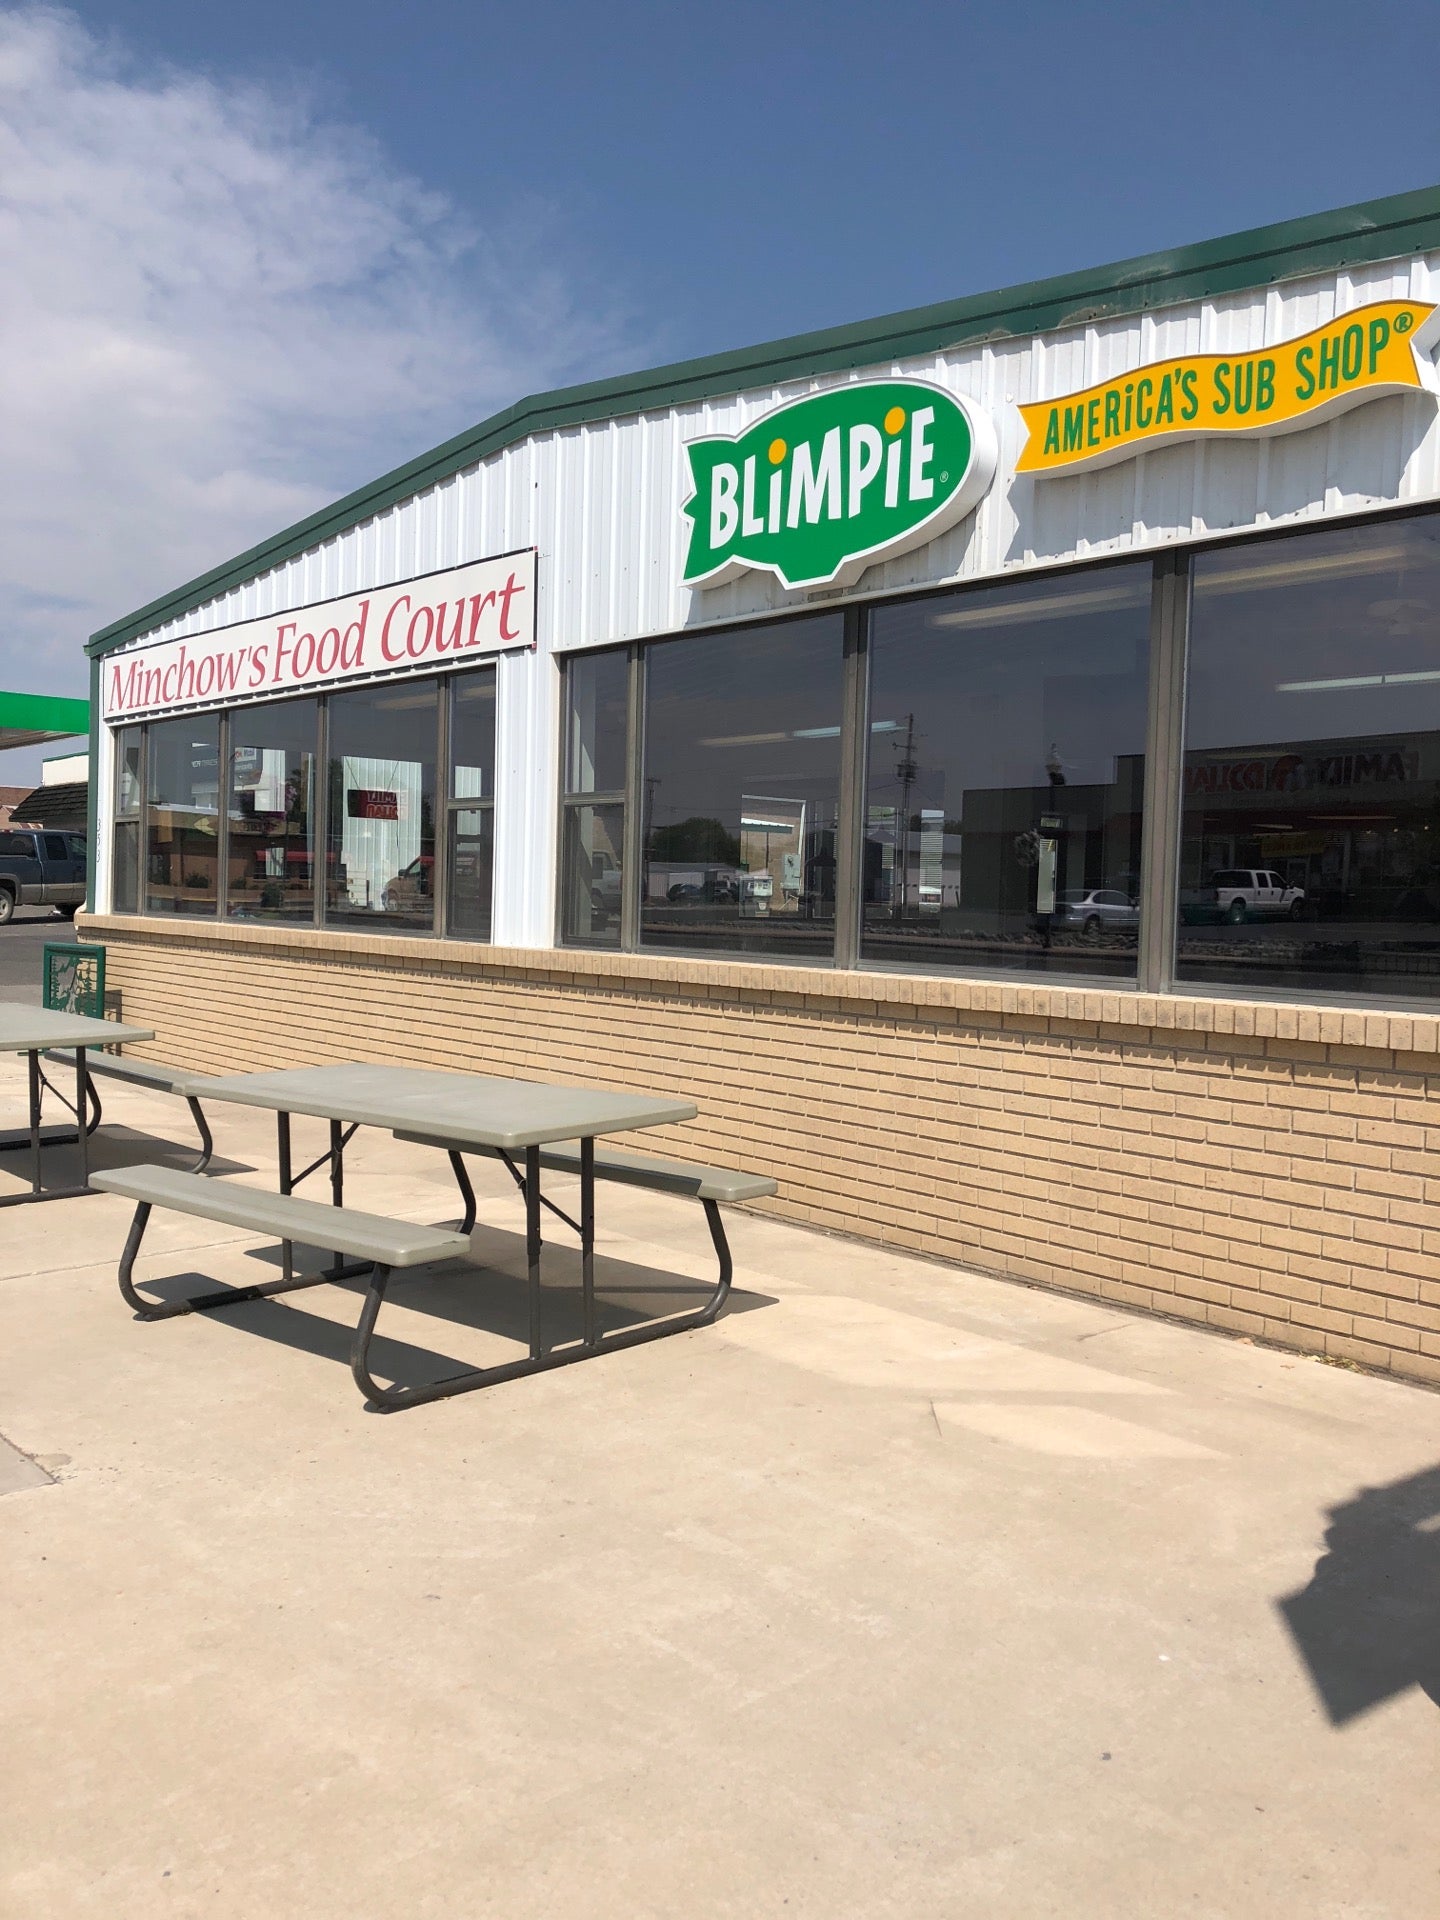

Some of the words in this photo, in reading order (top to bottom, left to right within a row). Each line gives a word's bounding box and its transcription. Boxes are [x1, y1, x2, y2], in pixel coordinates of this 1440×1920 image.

[1213, 359, 1276, 415] SUB
[1296, 318, 1390, 400] SHOP
[108, 644, 269, 712] Minchow's
[272, 599, 370, 683] Food
[380, 572, 526, 663] Court
